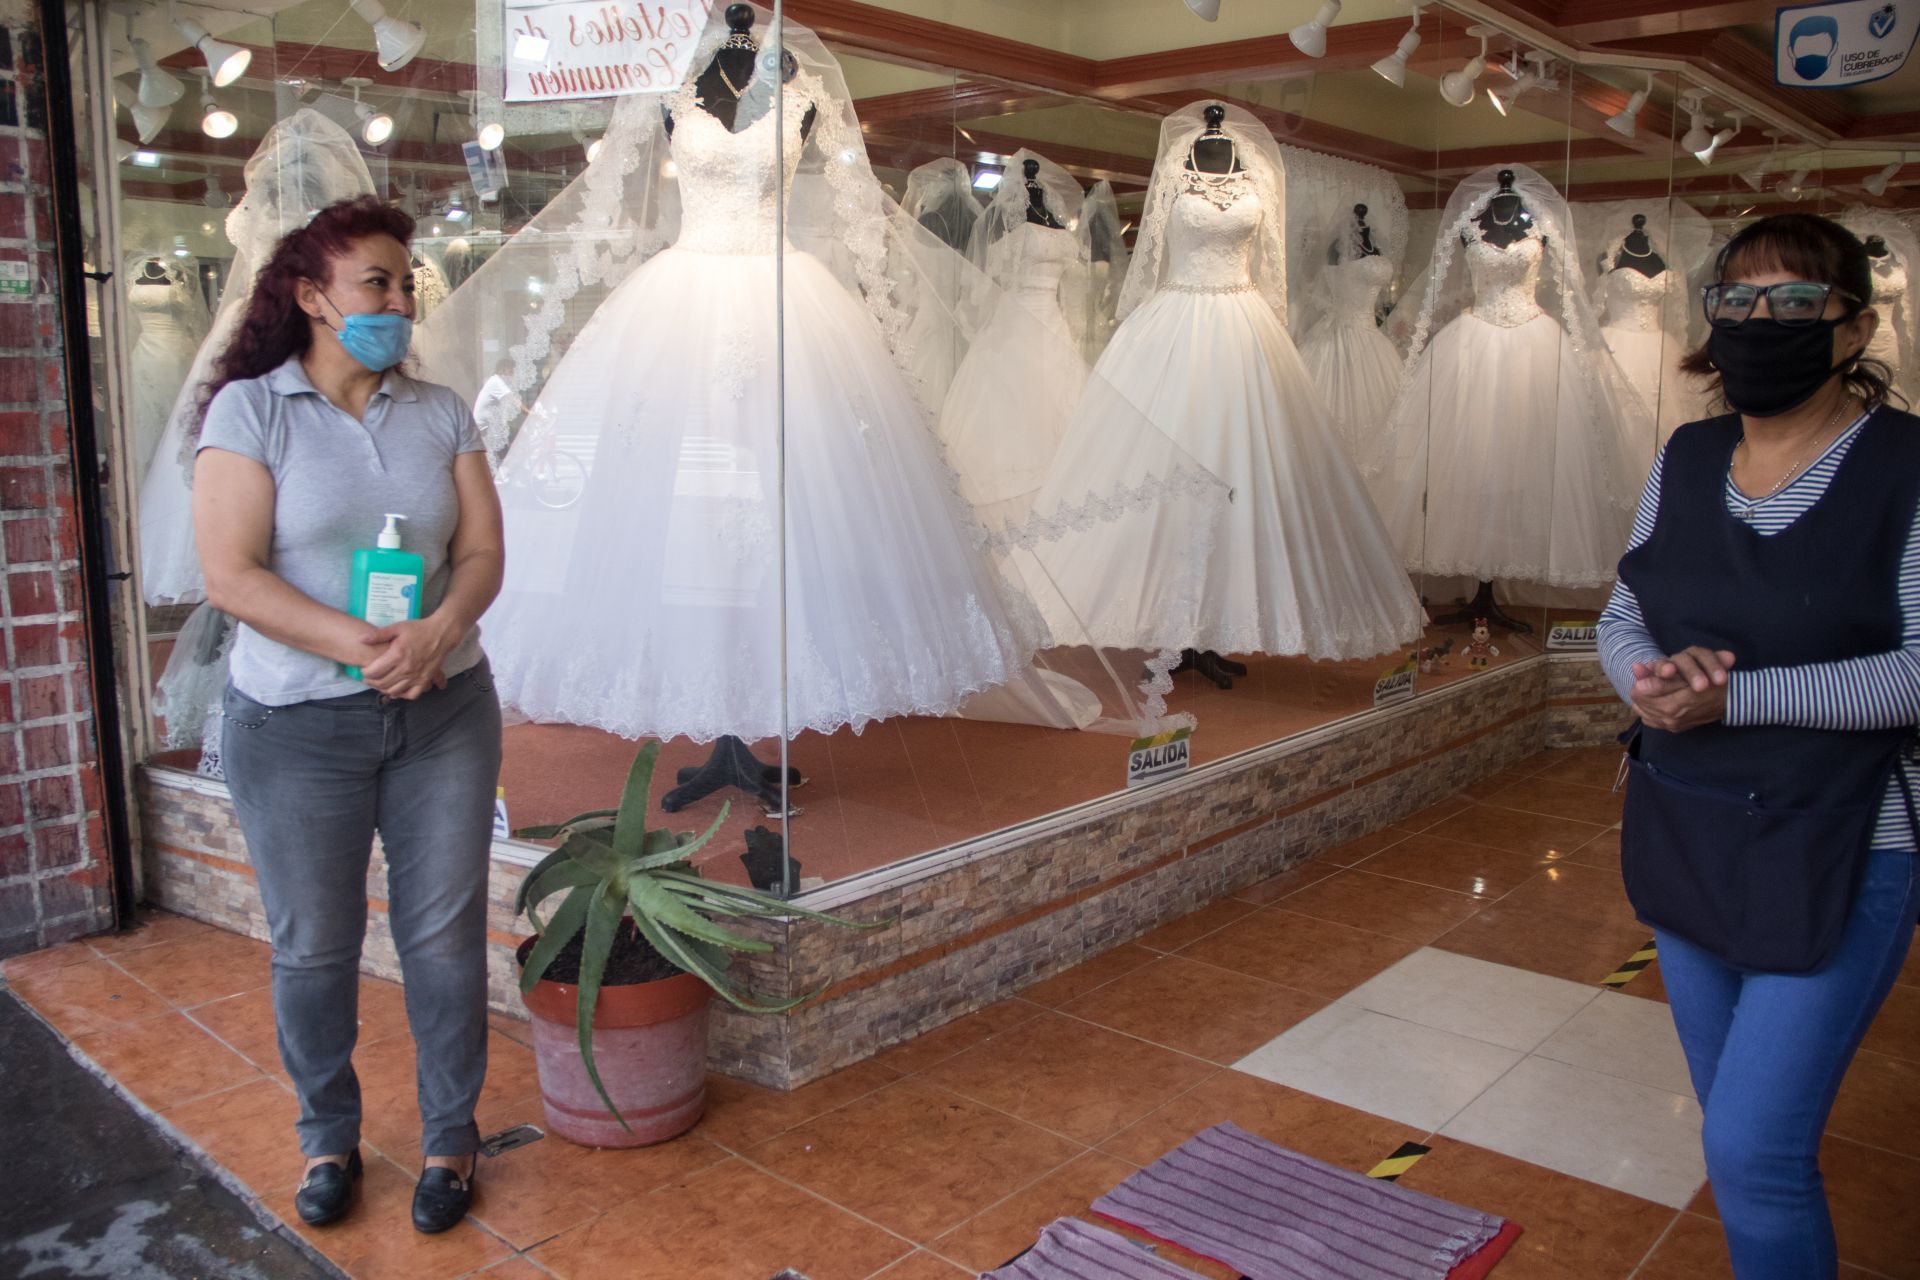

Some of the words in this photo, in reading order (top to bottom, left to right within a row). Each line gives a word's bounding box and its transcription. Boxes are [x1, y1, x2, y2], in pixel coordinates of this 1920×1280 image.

[1843, 51, 1905, 71] CUBREBOCAS
[1844, 52, 1866, 62] USO
[1867, 49, 1881, 59] DE
[1375, 671, 1413, 693] SALIDA
[1130, 741, 1188, 772] SALIDA
